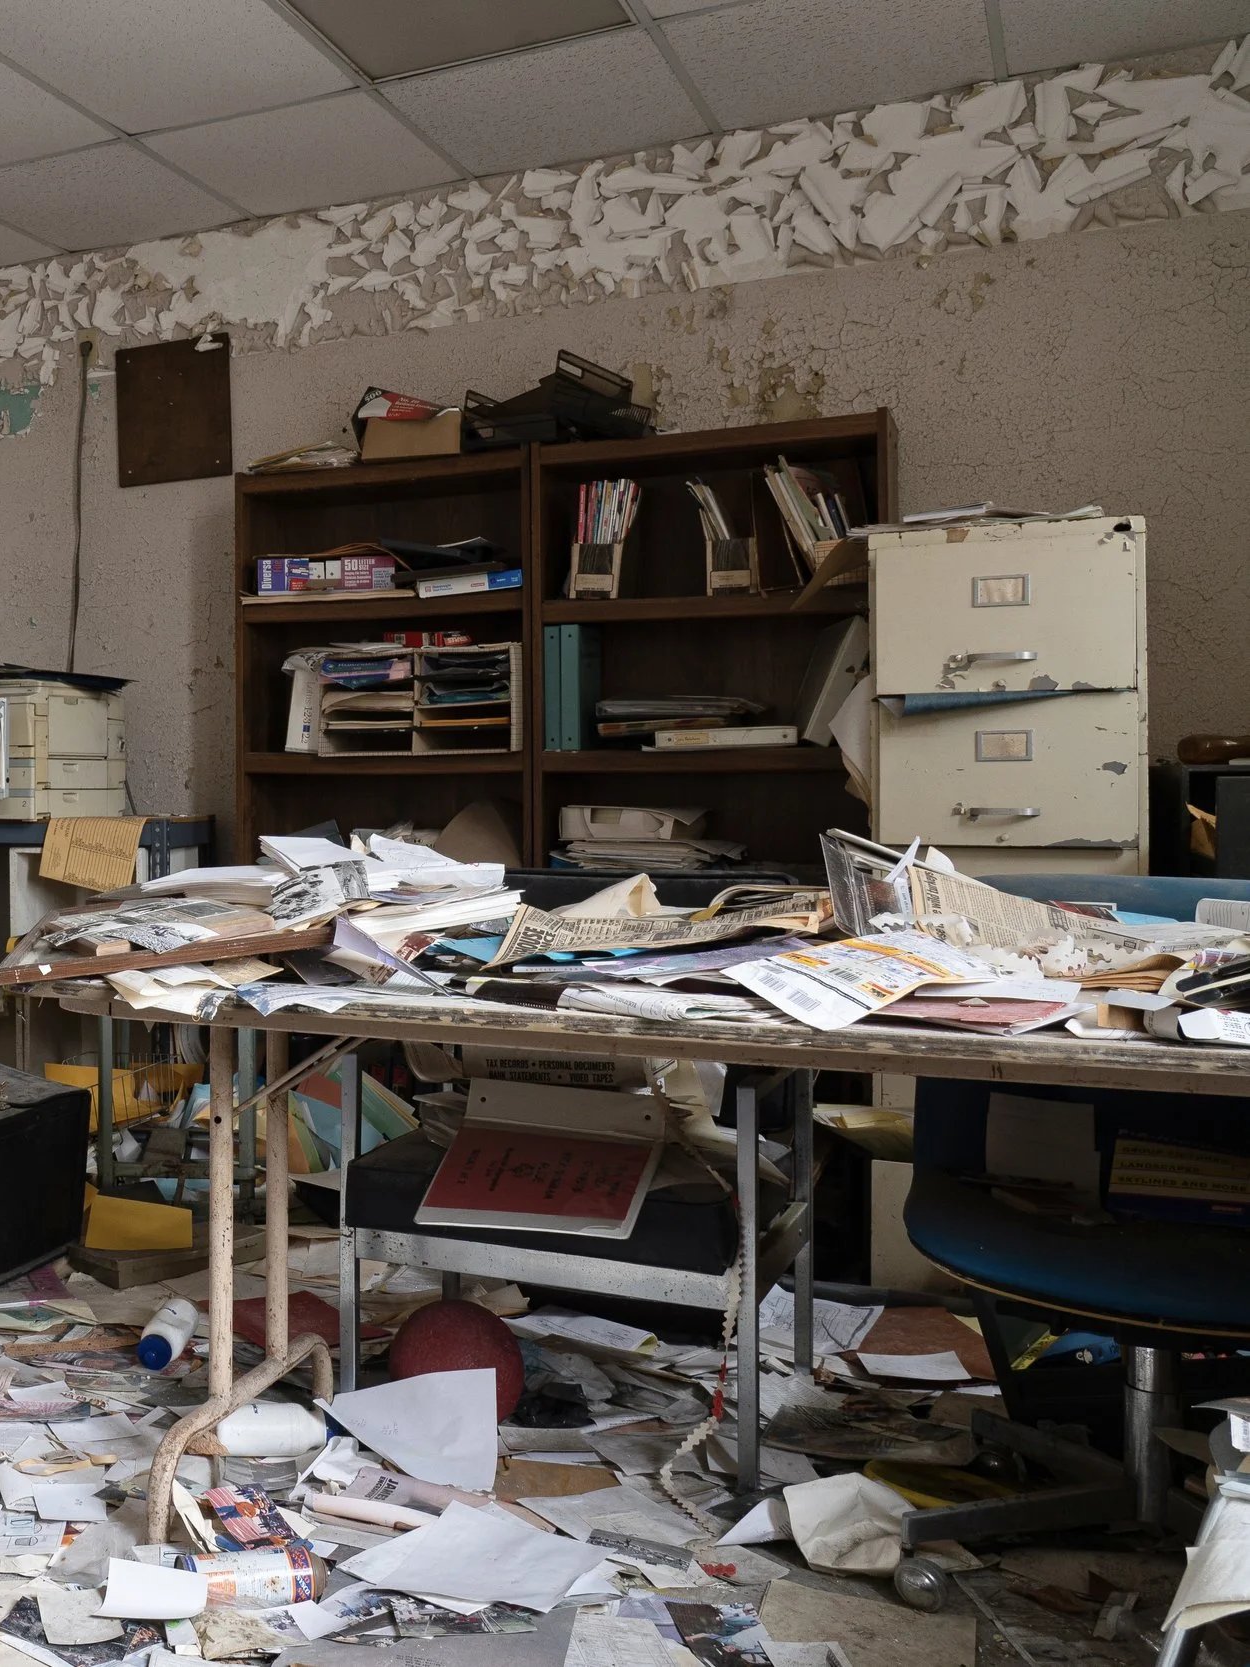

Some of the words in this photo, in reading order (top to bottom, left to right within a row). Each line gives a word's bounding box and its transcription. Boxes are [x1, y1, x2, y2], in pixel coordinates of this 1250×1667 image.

[364, 389, 383, 402] 500
[344, 559, 358, 571] 50
[485, 1059, 498, 1069] TAX
[499, 1059, 529, 1070] RECORDS
[538, 1060, 572, 1071] PERSONAL
[573, 1061, 616, 1072] DOCUMENTS
[509, 1071, 551, 1082] STATEMENTS
[569, 1073, 590, 1083] VIDEO
[592, 1073, 614, 1084] TAPES
[1119, 1161, 1201, 1173] LANDSCAPES
[1117, 1176, 1178, 1186] SKYLINES
[1181, 1180, 1209, 1188] AND
[1211, 1183, 1248, 1192] MORE
[373, 1478, 399, 1501] JAMES
[296, 1575, 310, 1596] SYSCO
